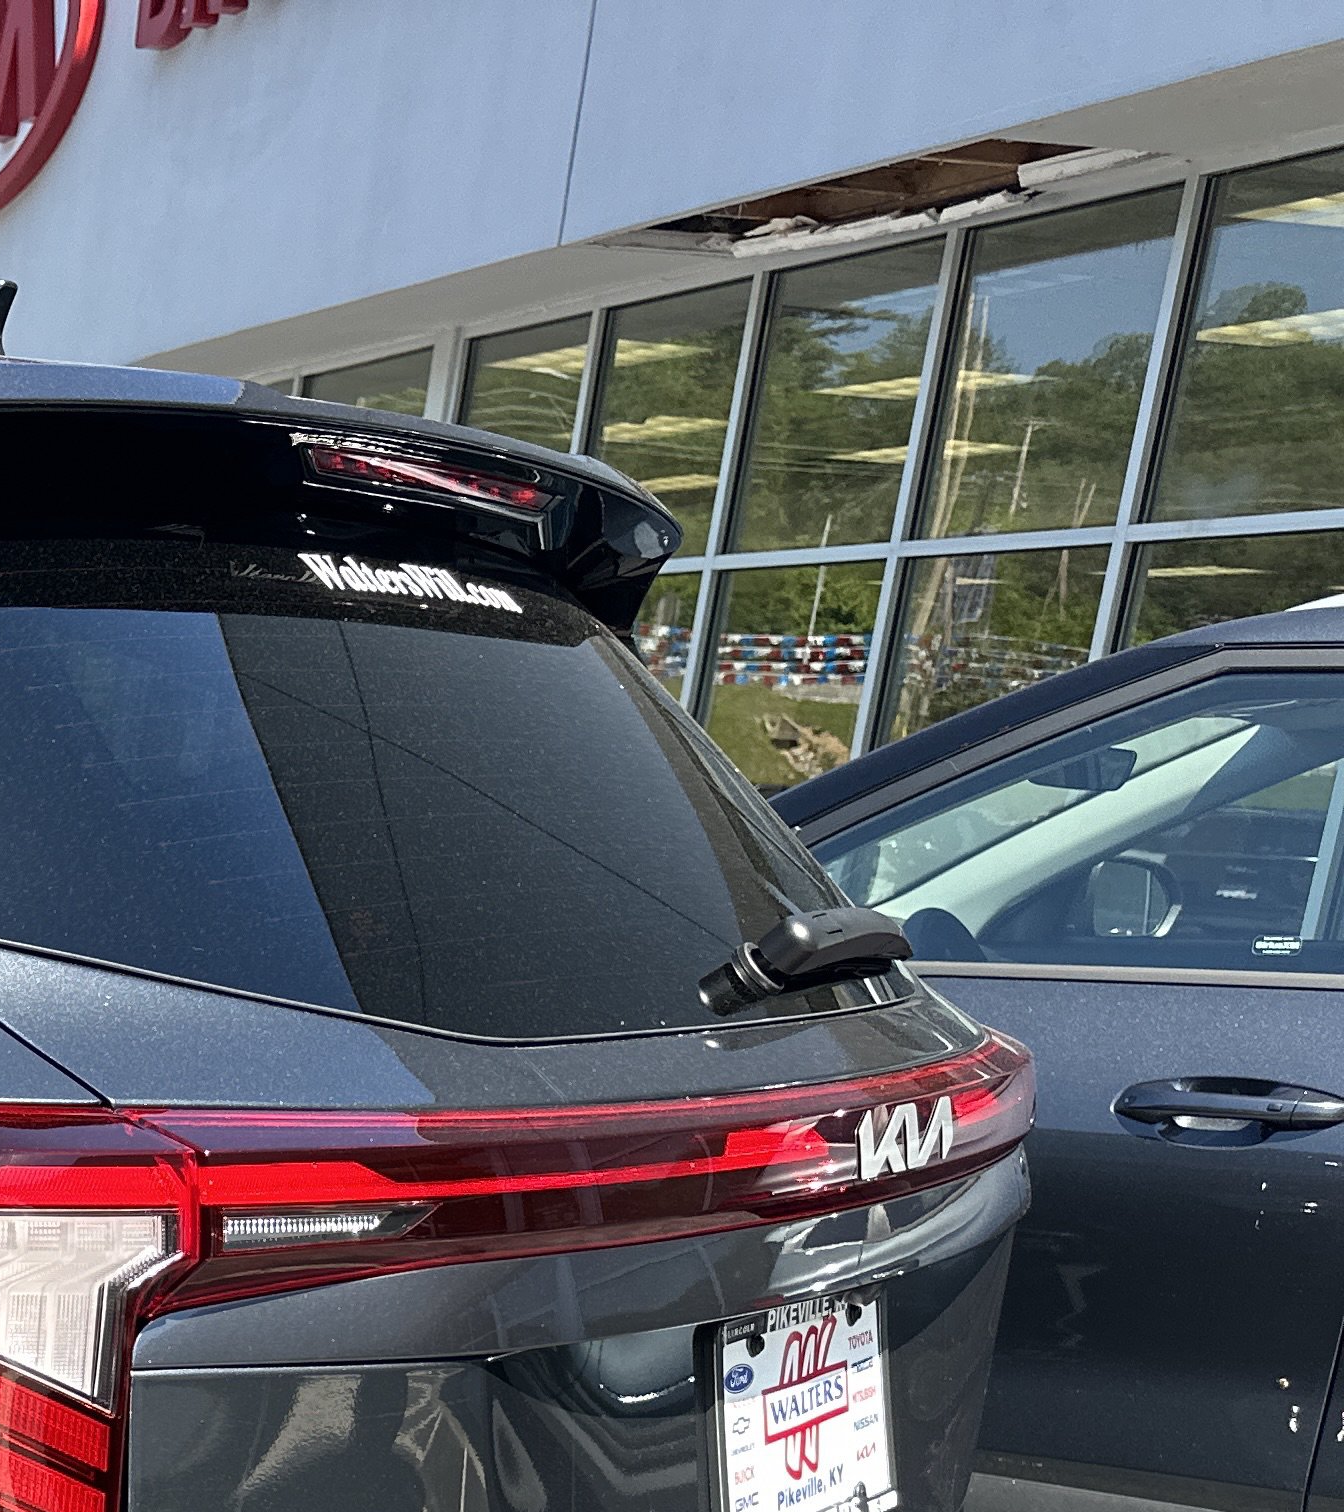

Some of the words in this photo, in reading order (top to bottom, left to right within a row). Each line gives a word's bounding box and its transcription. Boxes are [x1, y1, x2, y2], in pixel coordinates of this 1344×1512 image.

[298, 553, 523, 614] WaltersWill.com
[857, 1095, 954, 1181] KIA
[766, 1297, 833, 1334] PIKEVILLE,
[847, 1329, 874, 1351] TOYOTA
[730, 1367, 749, 1388] Ford
[769, 1375, 845, 1425] WALTERS
[856, 1442, 876, 1462] KIA
[734, 1491, 760, 1512] GMC
[777, 1476, 827, 1511] Pikeville,
[829, 1463, 844, 1487] KY
